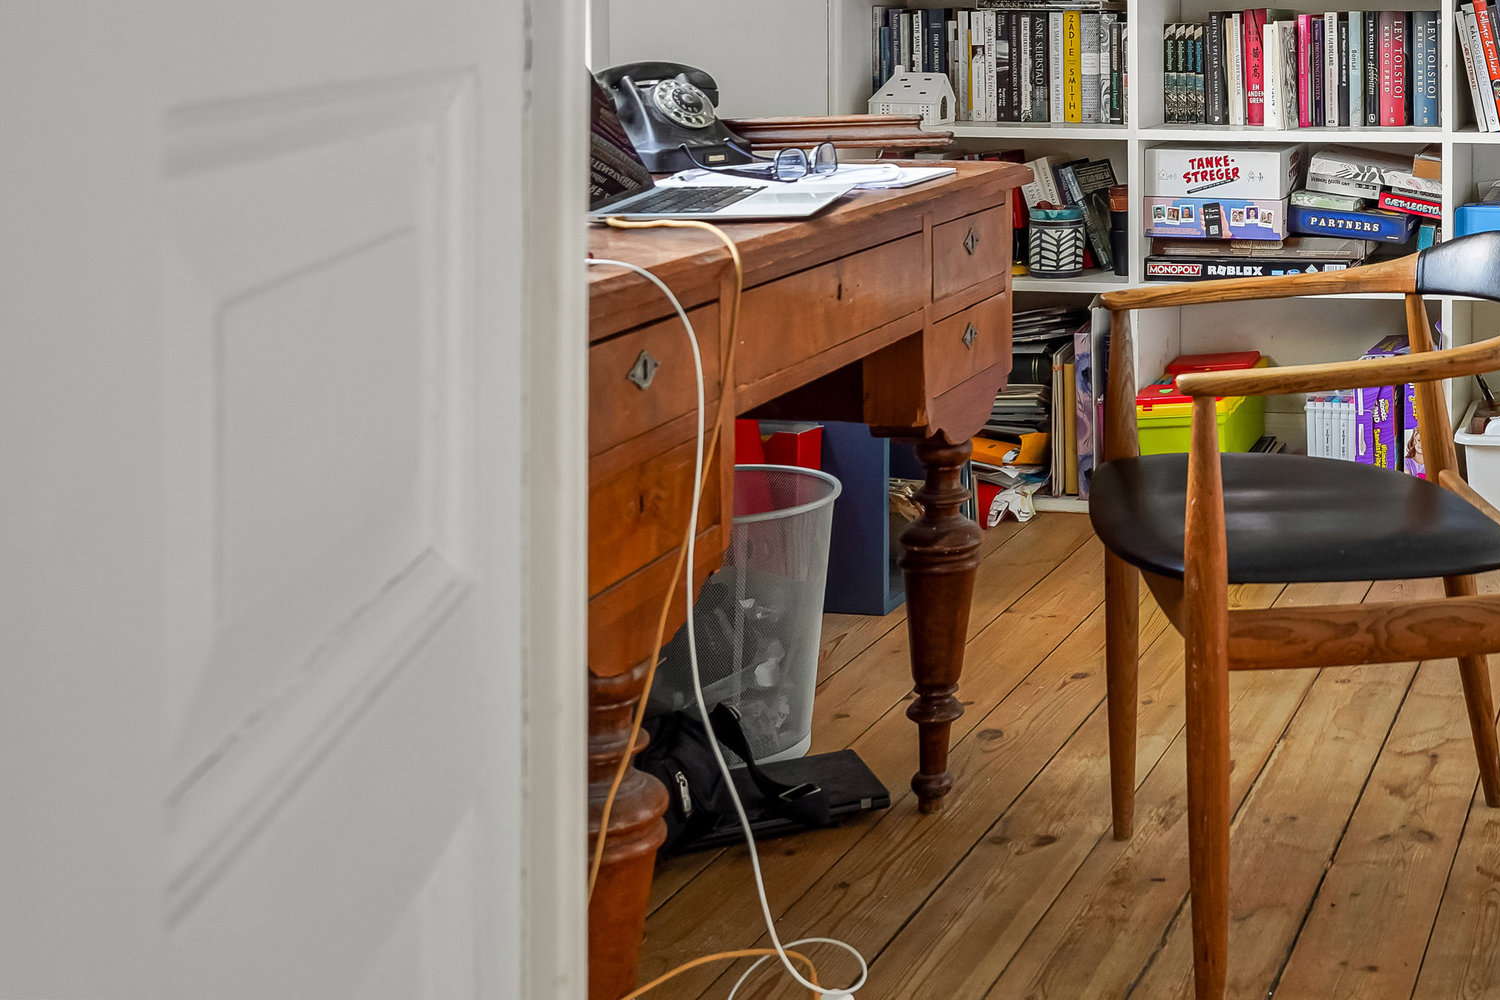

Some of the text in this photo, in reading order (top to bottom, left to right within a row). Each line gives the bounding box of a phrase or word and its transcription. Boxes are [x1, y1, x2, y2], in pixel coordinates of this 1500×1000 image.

[1035, 17, 1044, 85] ÅSNE SEIERSTAD
[1393, 20, 1403, 98] LEV TOLSTOJ
[1427, 20, 1436, 98] LEV TOLSTOJ
[1189, 155, 1235, 169] TANKE-
[1183, 167, 1240, 185] STREGER
[1310, 217, 1379, 232] PARTNERS
[1148, 265, 1201, 275] MONOPOLY
[1208, 265, 1263, 276] ROBLOX
[1374, 429, 1382, 467] Sandisfying
